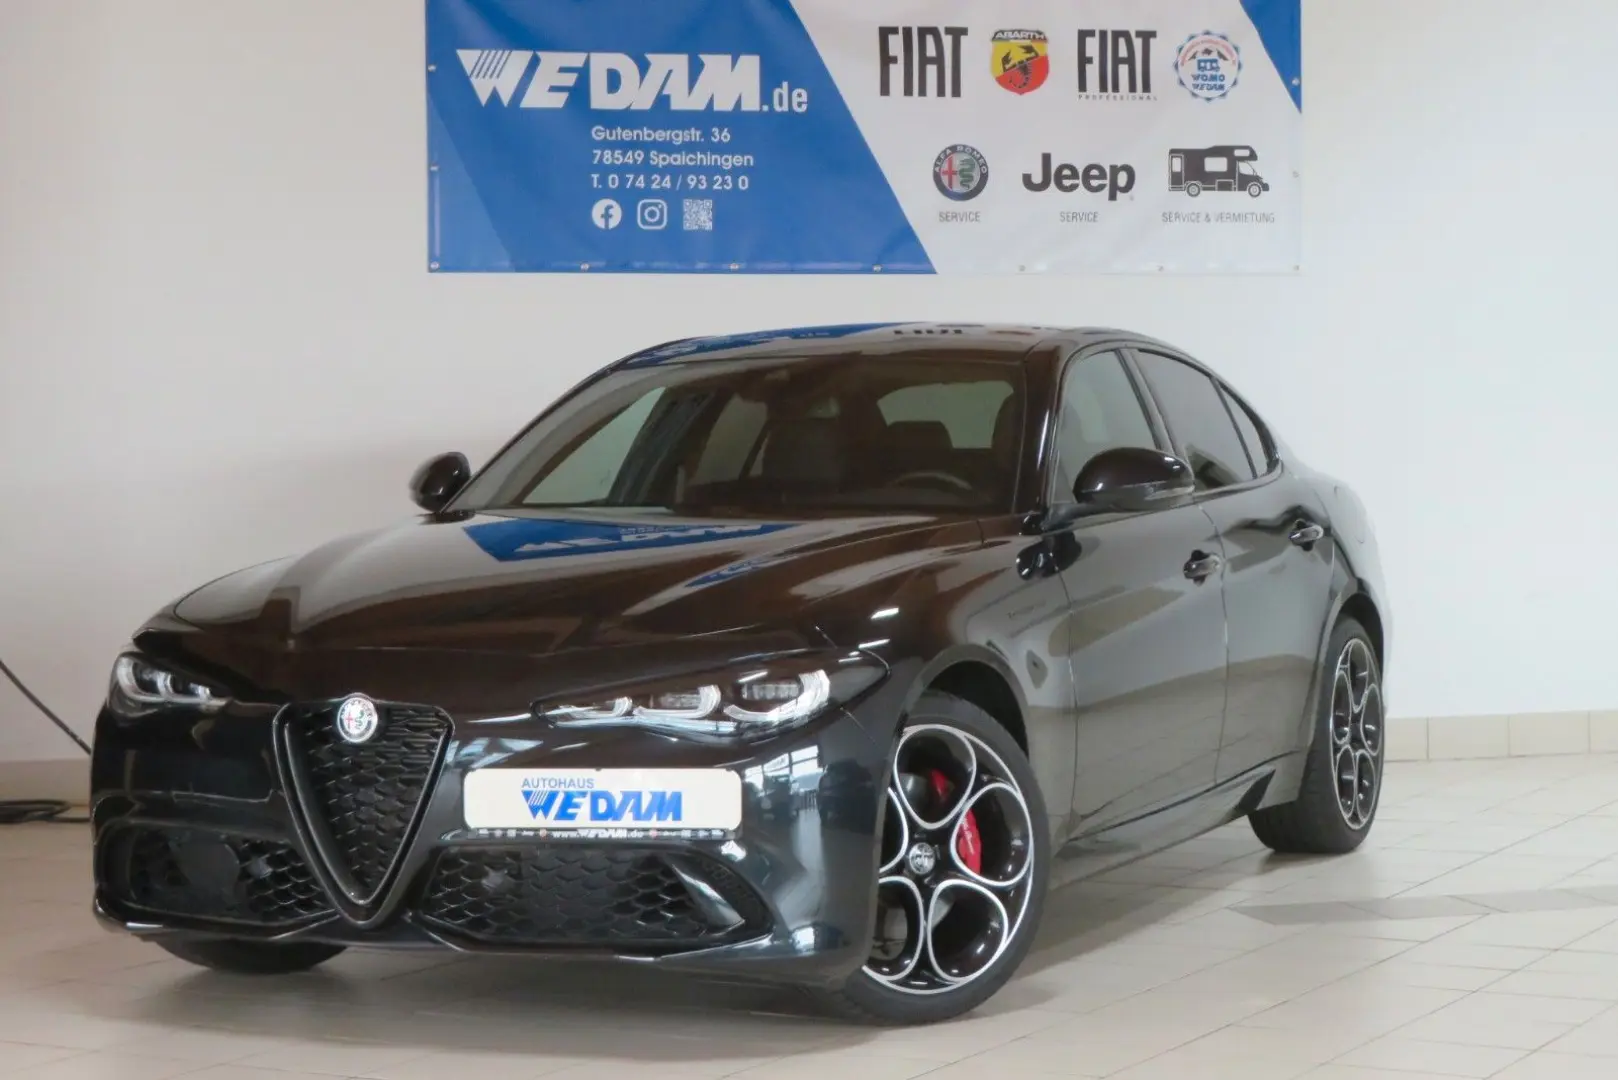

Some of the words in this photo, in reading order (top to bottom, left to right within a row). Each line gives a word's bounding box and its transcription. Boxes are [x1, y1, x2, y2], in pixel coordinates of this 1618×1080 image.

[994, 30, 1046, 40] ABARTH
[879, 26, 968, 98] FIAT
[1077, 29, 1157, 93] FIAT
[456, 49, 808, 112] WEDAM.de
[591, 125, 705, 145] Gutenbergstr.
[710, 127, 731, 143] 36
[592, 149, 645, 165] 78549
[649, 151, 754, 170] Spaichingen
[934, 148, 953, 173] ALFA
[956, 145, 988, 174] ROMEO
[591, 173, 602, 189] T.
[607, 173, 619, 189] 0
[625, 173, 645, 189] 74
[650, 174, 672, 190] 24
[687, 174, 707, 190] 93
[712, 175, 733, 190] 23
[738, 175, 749, 191] 0
[1022, 152, 1136, 202] Jeep
[939, 211, 981, 222] SERVICE
[1059, 211, 1099, 223] SERVICE
[1161, 211, 1201, 223] SERVICE
[1204, 212, 1211, 223] &
[1215, 212, 1275, 223] VERMIETUNG
[521, 777, 595, 789] AUTOHAUS
[521, 790, 683, 821] WEDAM
